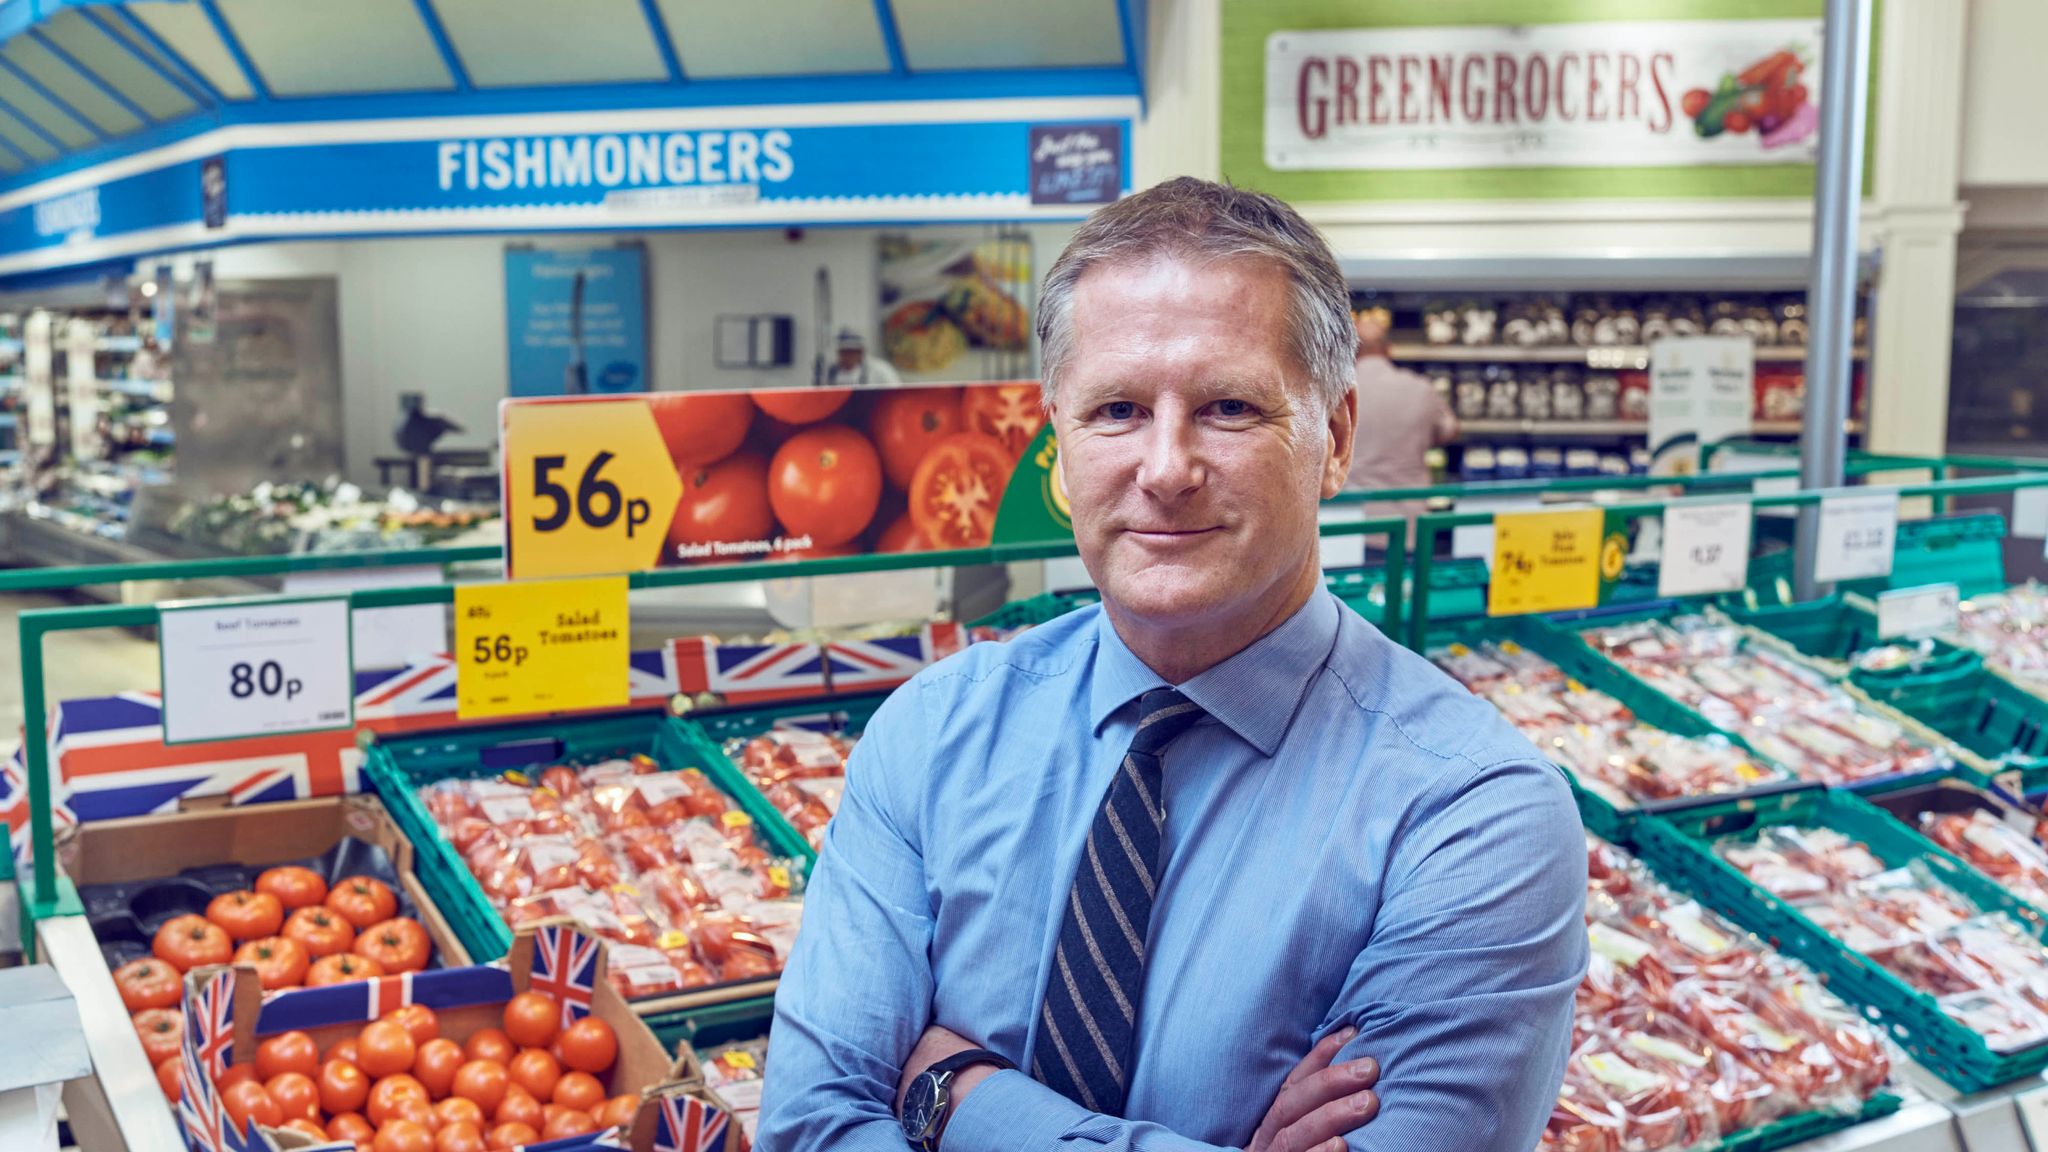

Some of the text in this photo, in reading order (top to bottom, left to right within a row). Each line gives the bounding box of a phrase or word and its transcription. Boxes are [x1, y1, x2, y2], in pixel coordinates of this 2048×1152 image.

[1297, 51, 1675, 140] GREENGROCERS
[438, 130, 794, 191] FISHMONGERS
[532, 450, 652, 540] 56p
[677, 540, 712, 559] Salad
[215, 616, 301, 632] Beef Tomatoes
[556, 610, 601, 629] Salad
[474, 634, 529, 667] 56p
[538, 628, 619, 646] Tomatoes
[230, 660, 304, 702] 80p
